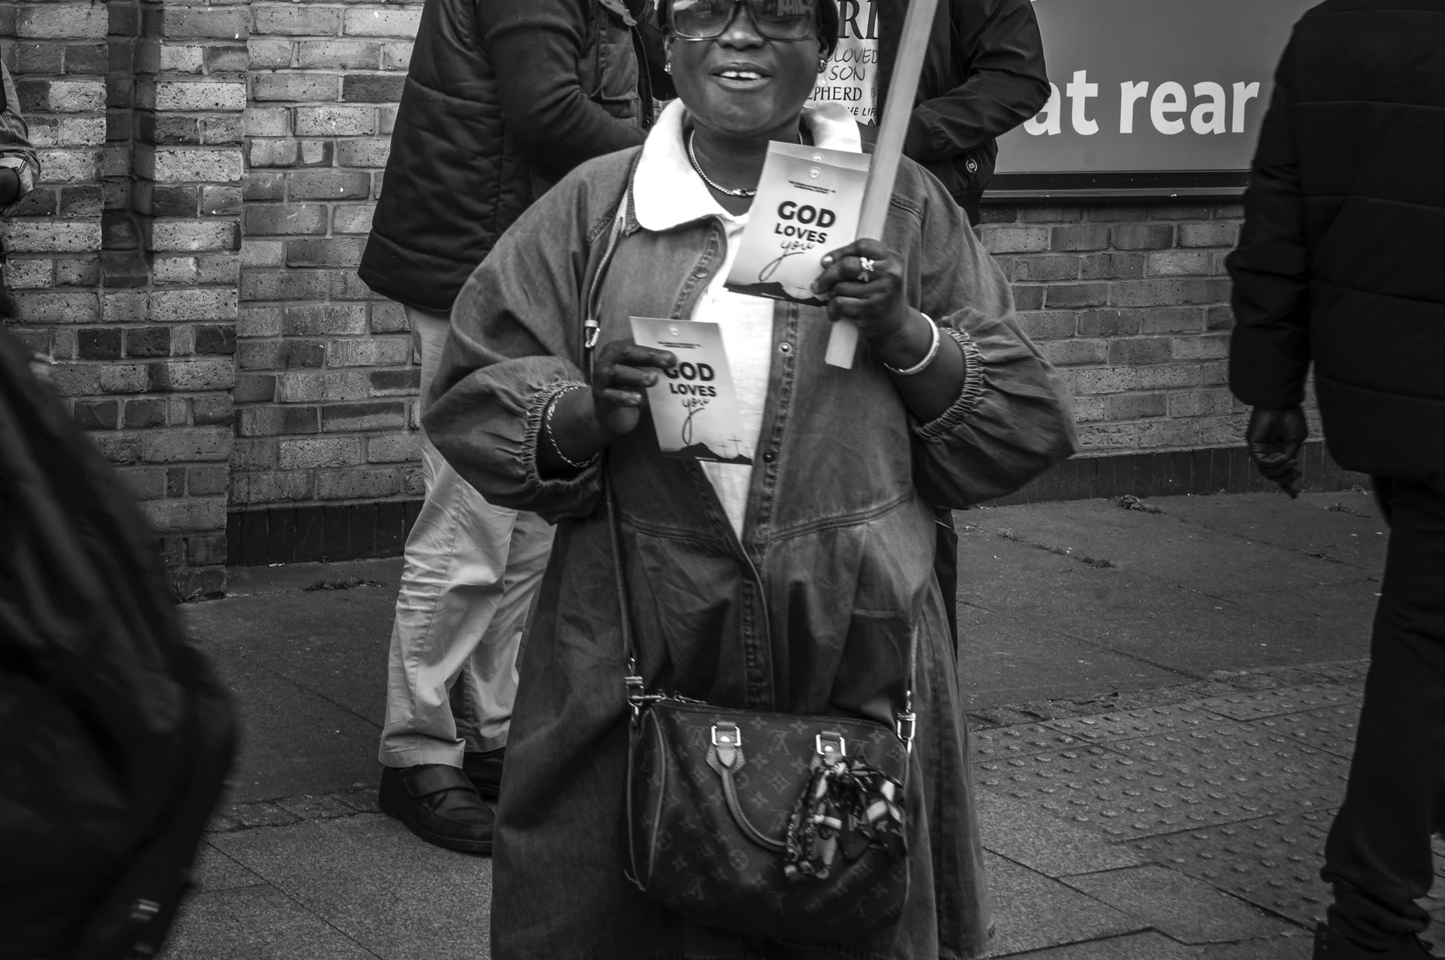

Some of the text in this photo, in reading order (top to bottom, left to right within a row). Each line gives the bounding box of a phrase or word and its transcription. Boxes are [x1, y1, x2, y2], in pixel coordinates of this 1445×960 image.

[828, 65, 866, 81] SON
[1023, 69, 1260, 136] at rear
[777, 200, 837, 228] GOD
[774, 223, 828, 244] LOVES
[669, 382, 717, 397] LOVES
